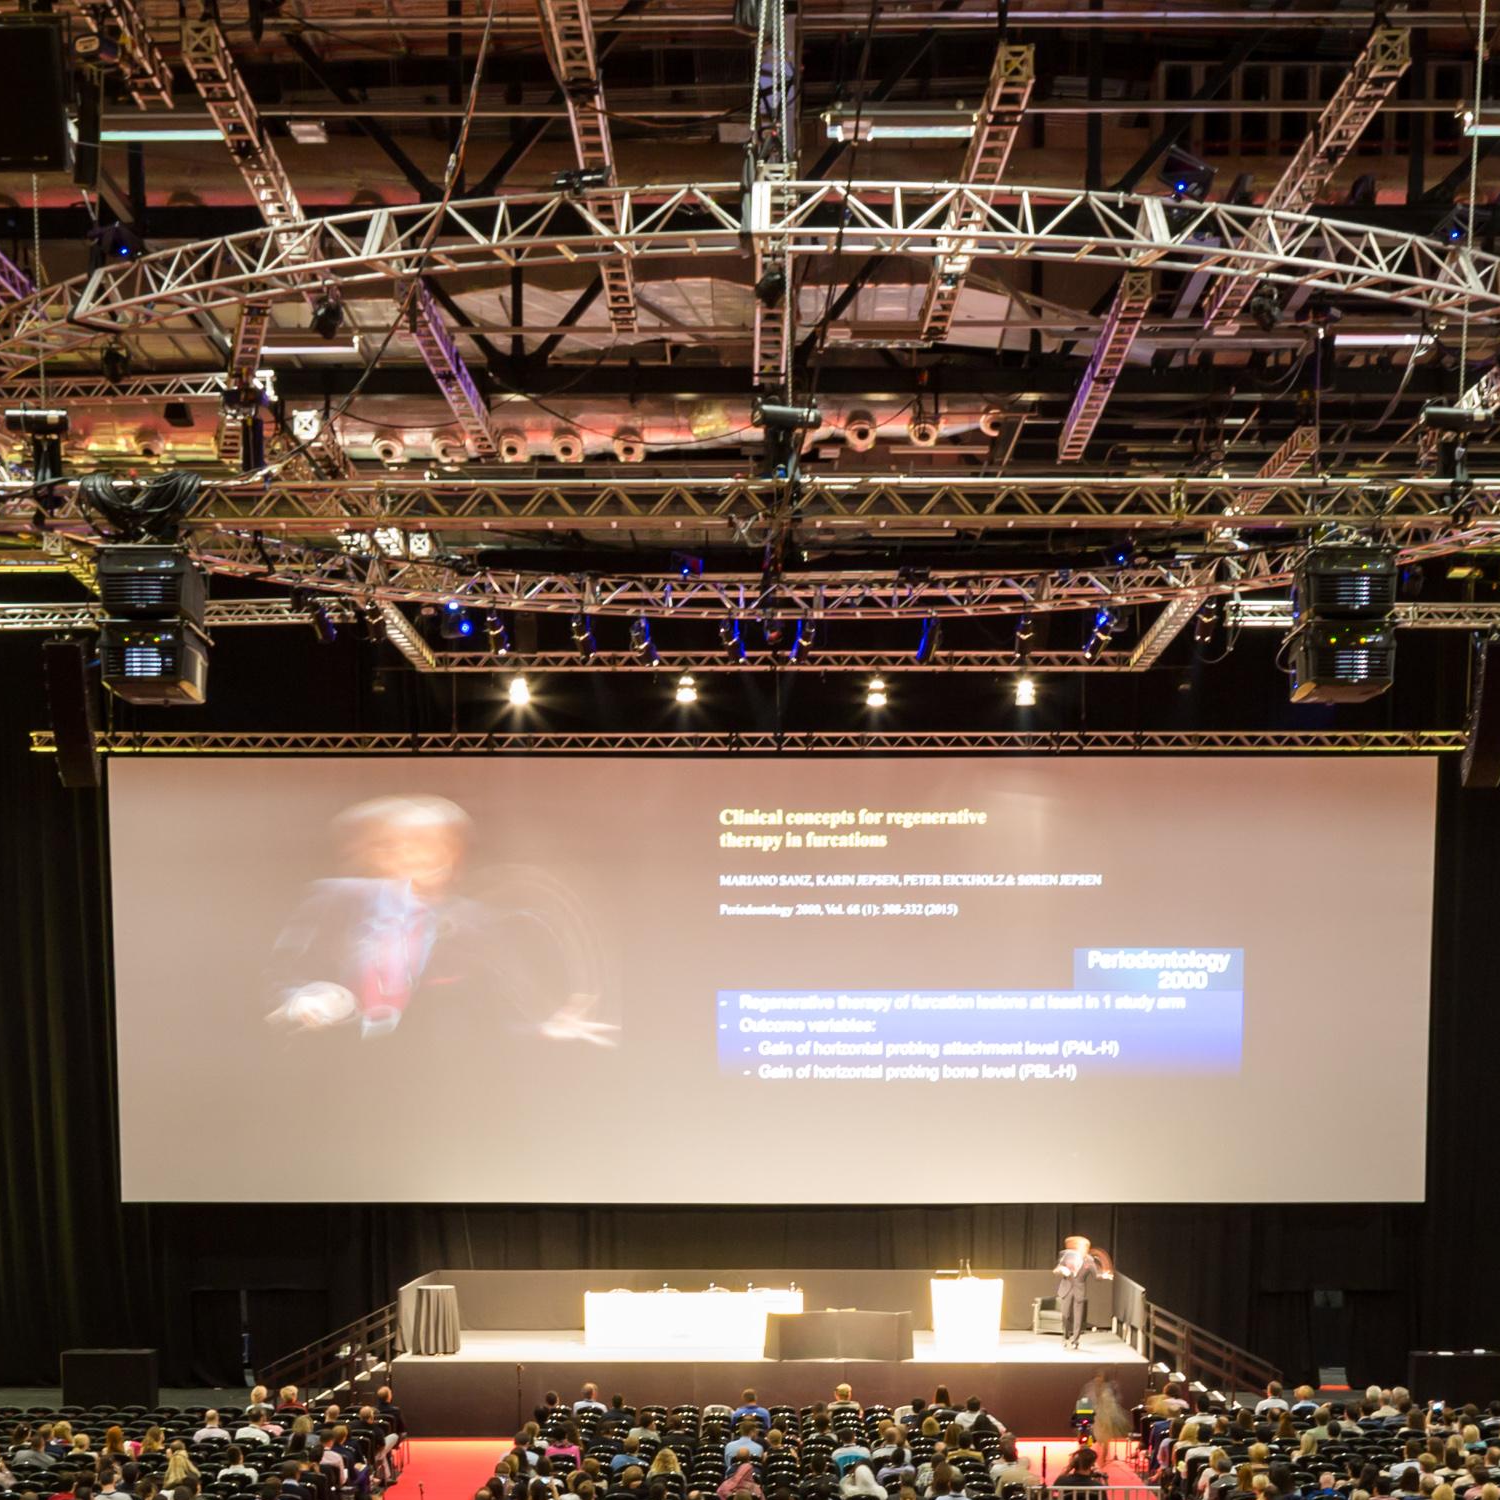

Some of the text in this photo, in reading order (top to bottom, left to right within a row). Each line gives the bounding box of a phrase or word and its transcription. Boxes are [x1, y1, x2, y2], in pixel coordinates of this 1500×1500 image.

[719, 809, 987, 828] Clinical concepts for regenerative
[719, 832, 887, 851] therapy in furcations
[719, 875, 778, 886] MARIANO
[779, 875, 814, 887] SANZ,
[816, 875, 855, 886] KARIN
[856, 875, 902, 886] JEPSEN,
[903, 875, 941, 886] PETER
[1059, 874, 1102, 886] JEPSEN
[719, 904, 793, 917] Periodontology
[1088, 950, 1230, 974] Periodontology
[1157, 971, 1208, 989] 2000
[739, 994, 835, 1013] Regenerative
[837, 995, 892, 1012] therapy
[894, 994, 910, 1009] of
[911, 994, 975, 1009] furcation
[1030, 995, 1046, 1009] at
[1086, 995, 1099, 1008] in
[1103, 994, 1111, 1009] 1
[1115, 994, 1156, 1012] study
[1156, 997, 1186, 1009] arm
[739, 1017, 876, 1032] Outcome variables:
[758, 1040, 1119, 1058] Gain of horizontal probing attachment level (PAL-H)
[758, 1064, 1077, 1081] Gain of horizontal probing bone level (PBL-H)
